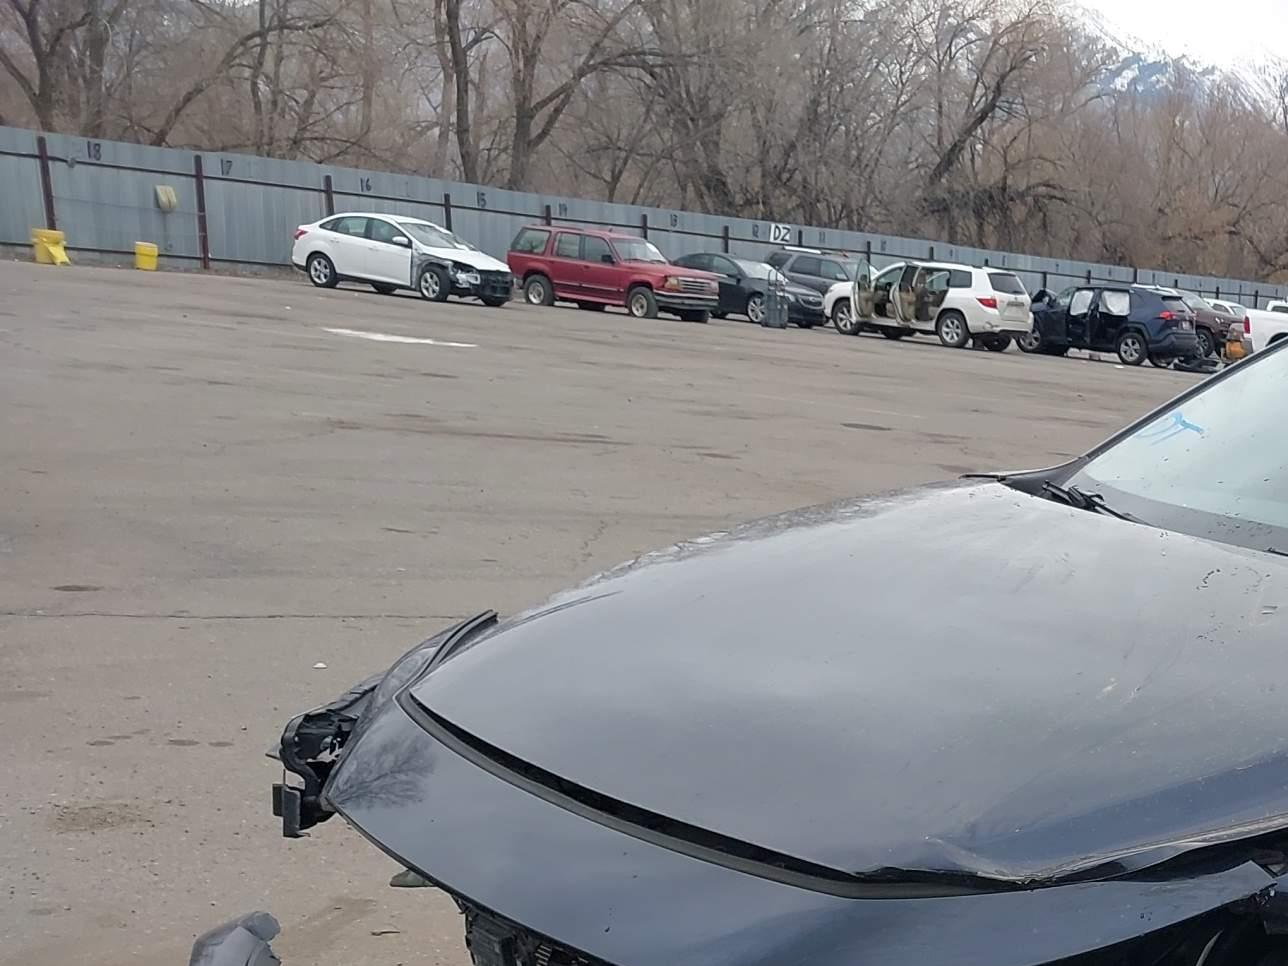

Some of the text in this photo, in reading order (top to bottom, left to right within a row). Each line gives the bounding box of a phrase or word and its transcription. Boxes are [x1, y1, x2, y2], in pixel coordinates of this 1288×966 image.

[87, 140, 102, 161] 18
[221, 158, 233, 176] 17
[360, 178, 372, 193] 16
[477, 191, 487, 208] 15
